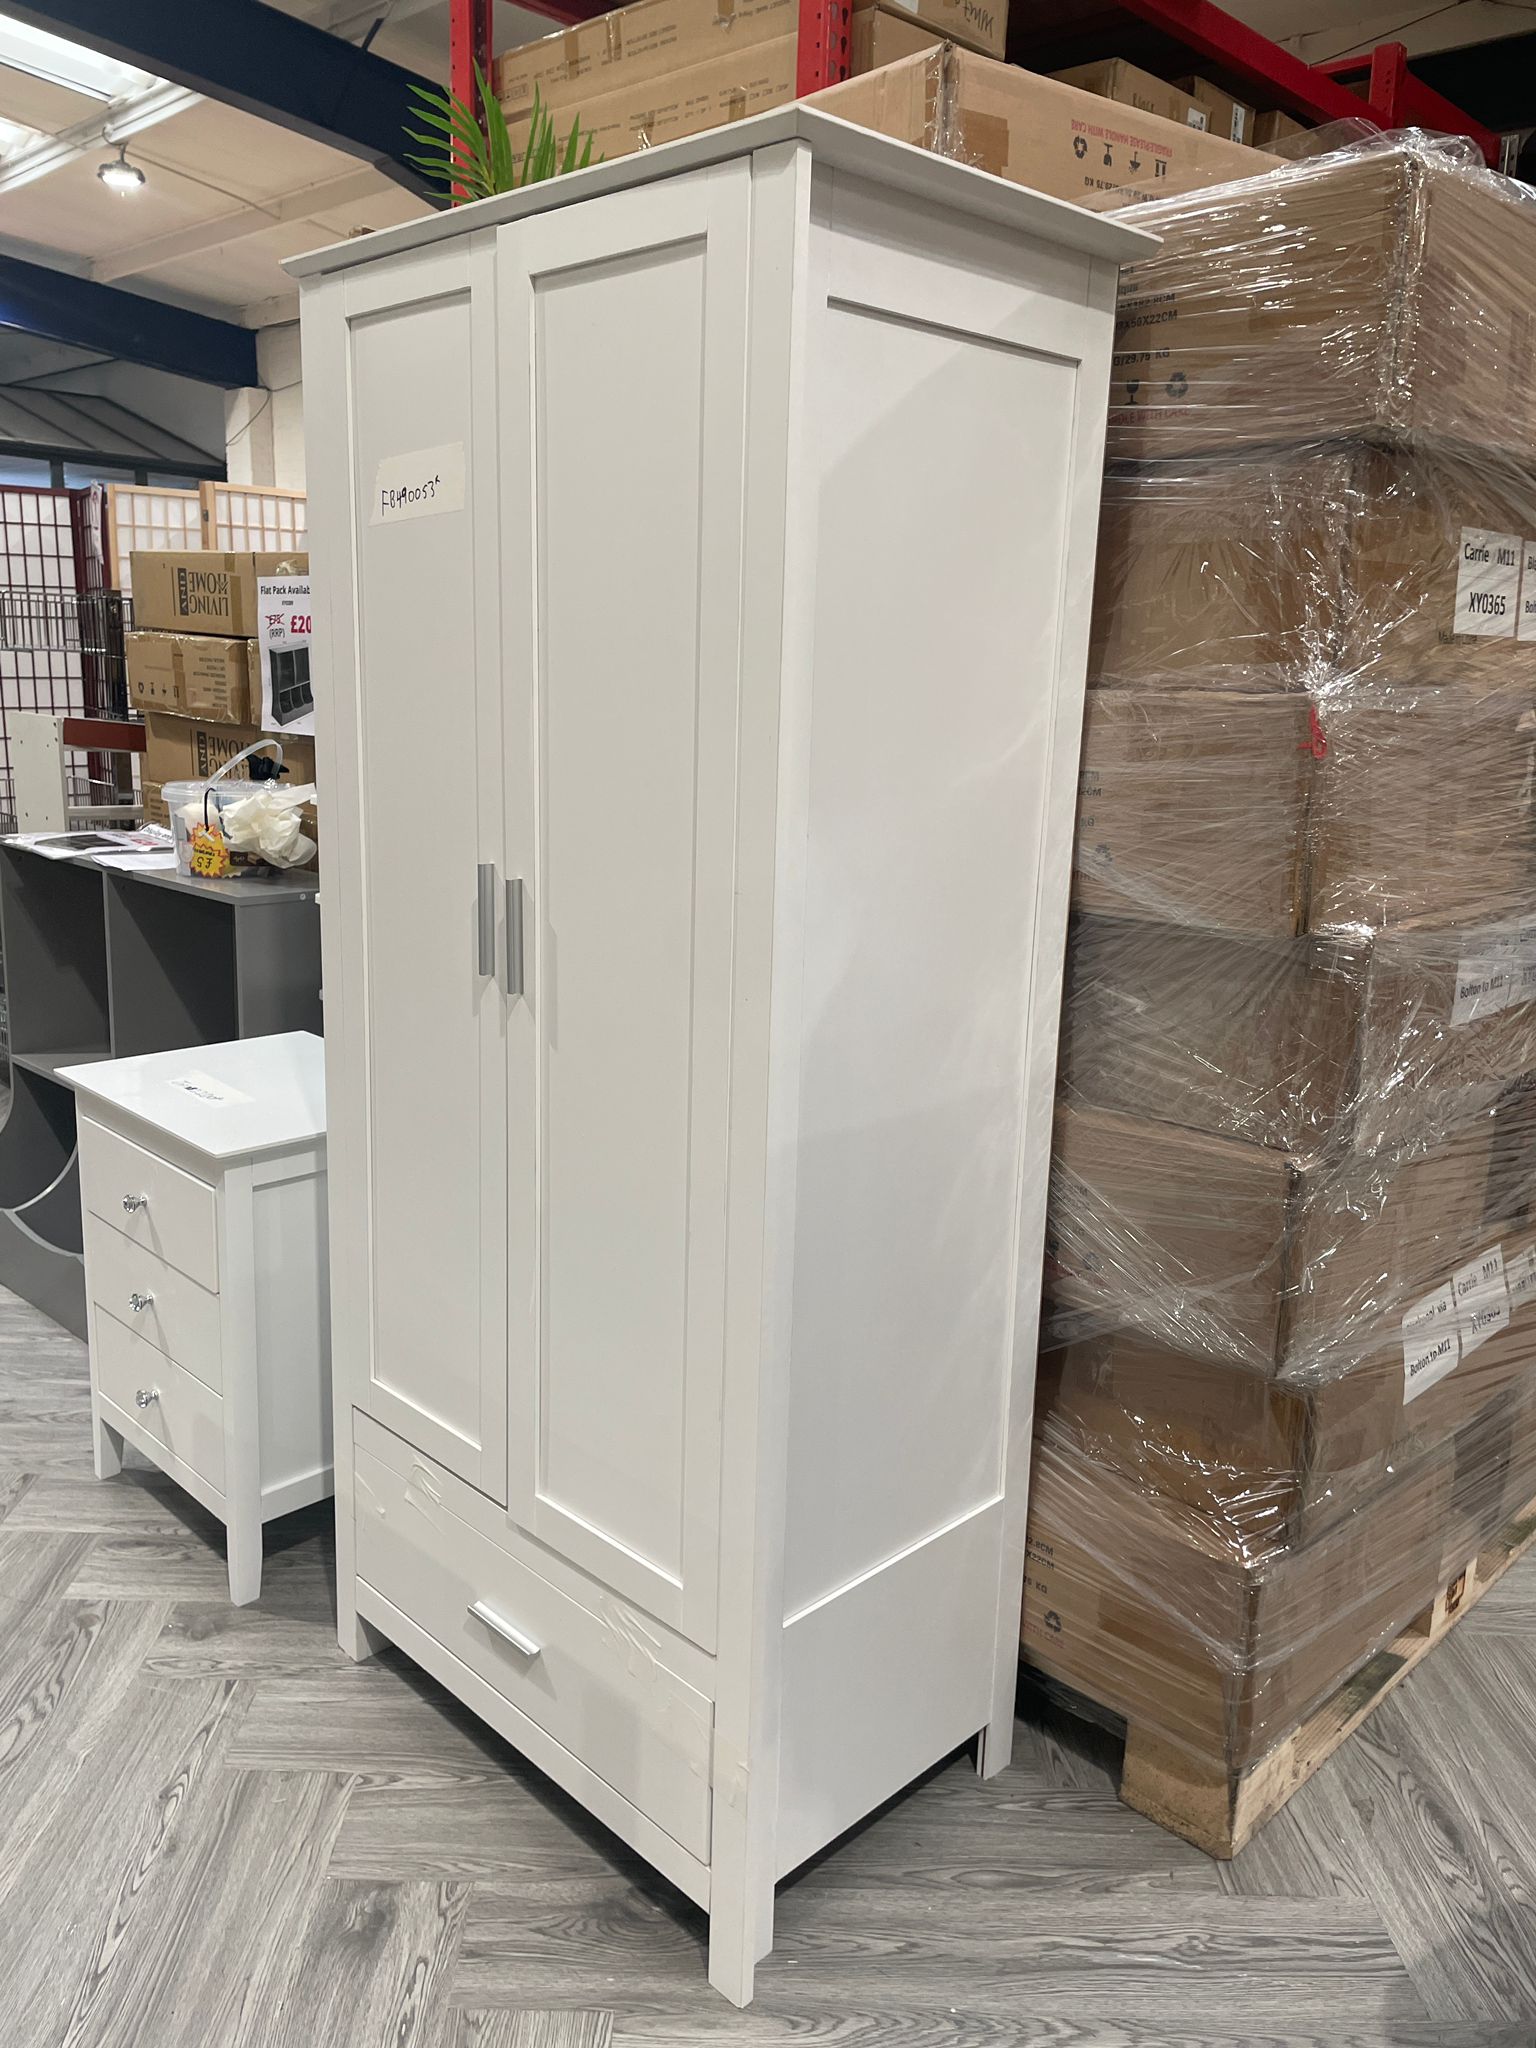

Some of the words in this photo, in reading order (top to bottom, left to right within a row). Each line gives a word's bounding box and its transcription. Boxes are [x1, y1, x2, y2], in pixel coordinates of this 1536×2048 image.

[1071, 119, 1087, 133] CARE
[1087, 123, 1105, 139] WITH
[1464, 543, 1490, 562] Carrie
[1496, 548, 1516, 566] M11
[188, 571, 229, 595] HOME
[260, 585, 272, 595] Flat
[272, 585, 287, 595] Pack
[189, 594, 229, 616] LIVING
[1468, 592, 1506, 615] XY0365
[1410, 1351, 1430, 1377] Bolton
